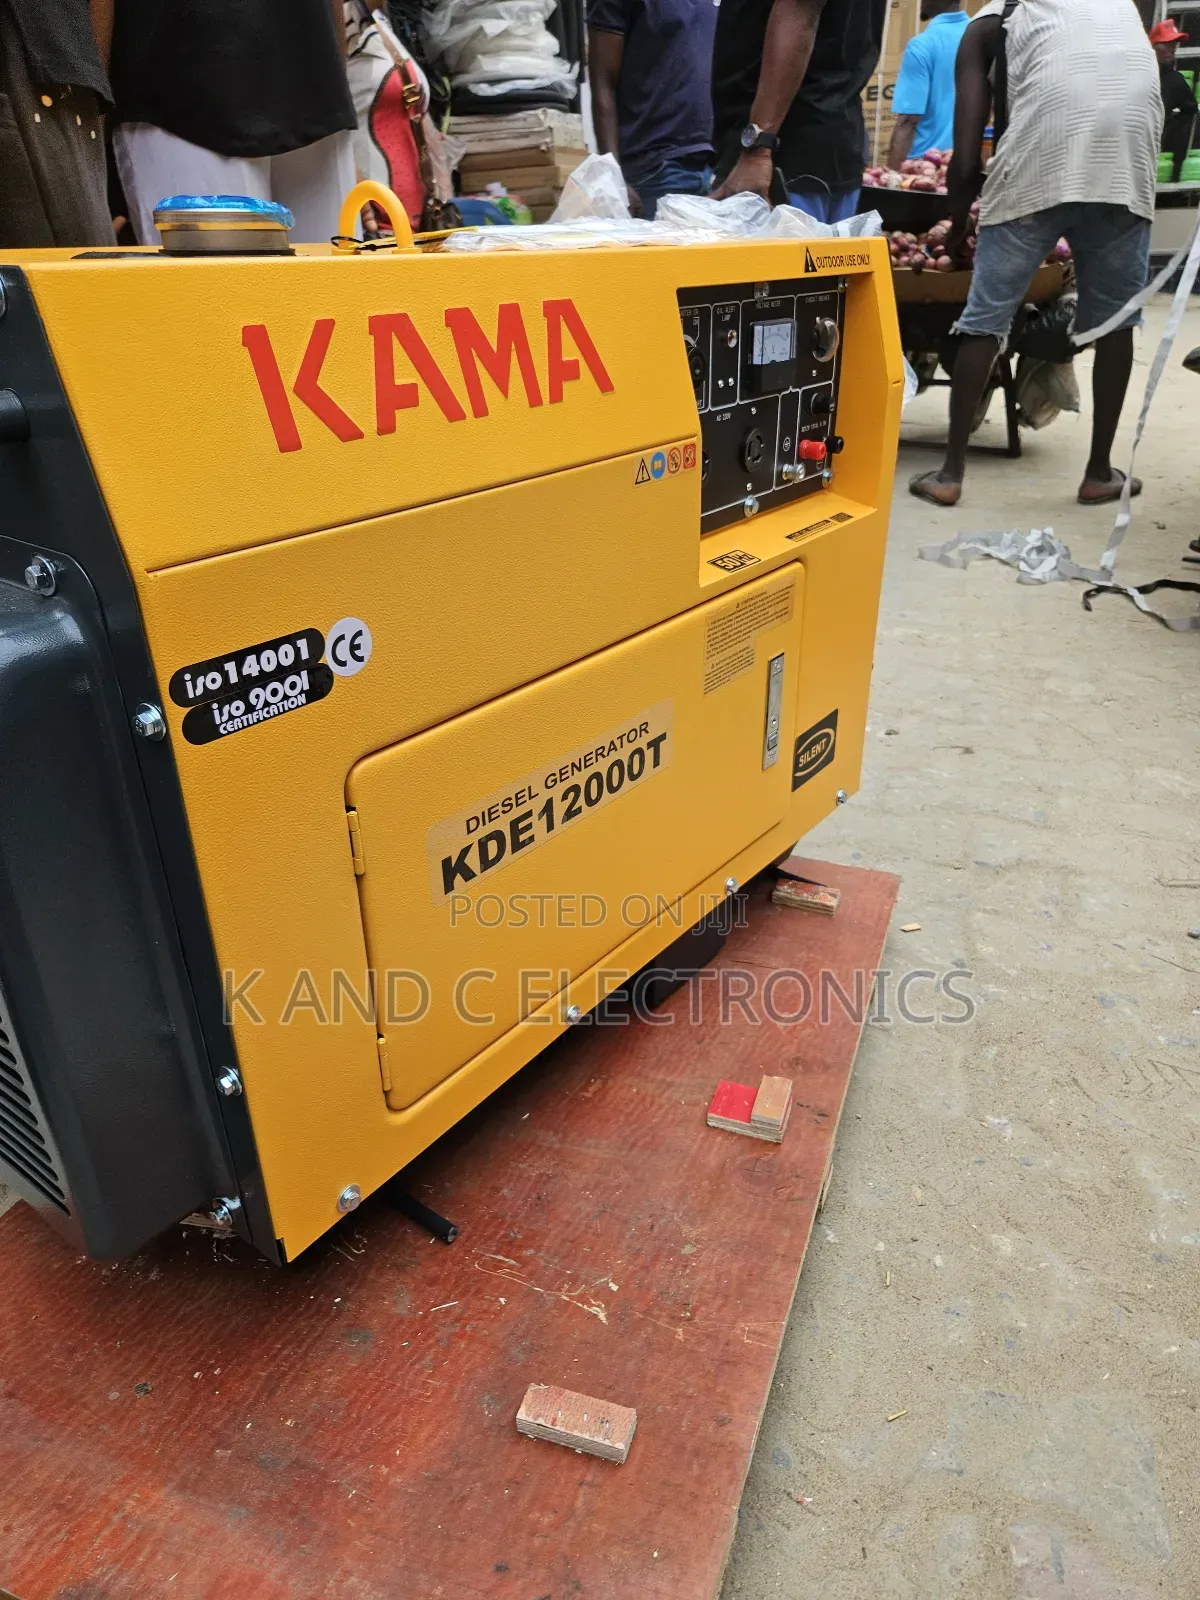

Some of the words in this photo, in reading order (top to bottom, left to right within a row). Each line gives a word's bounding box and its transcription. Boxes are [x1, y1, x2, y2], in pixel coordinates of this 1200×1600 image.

[816, 255, 845, 268] OUTDOOR
[845, 254, 857, 267] USE
[857, 253, 871, 266] ONLY
[242, 298, 615, 453] KAMA
[224, 638, 309, 684] 14001
[331, 629, 365, 667] CE
[219, 693, 307, 735] CERTIFICATION
[798, 737, 827, 767] SILENT
[465, 785, 539, 835] DIESEL
[544, 721, 650, 790] GENERATOR
[441, 731, 667, 895] KDE12000T
